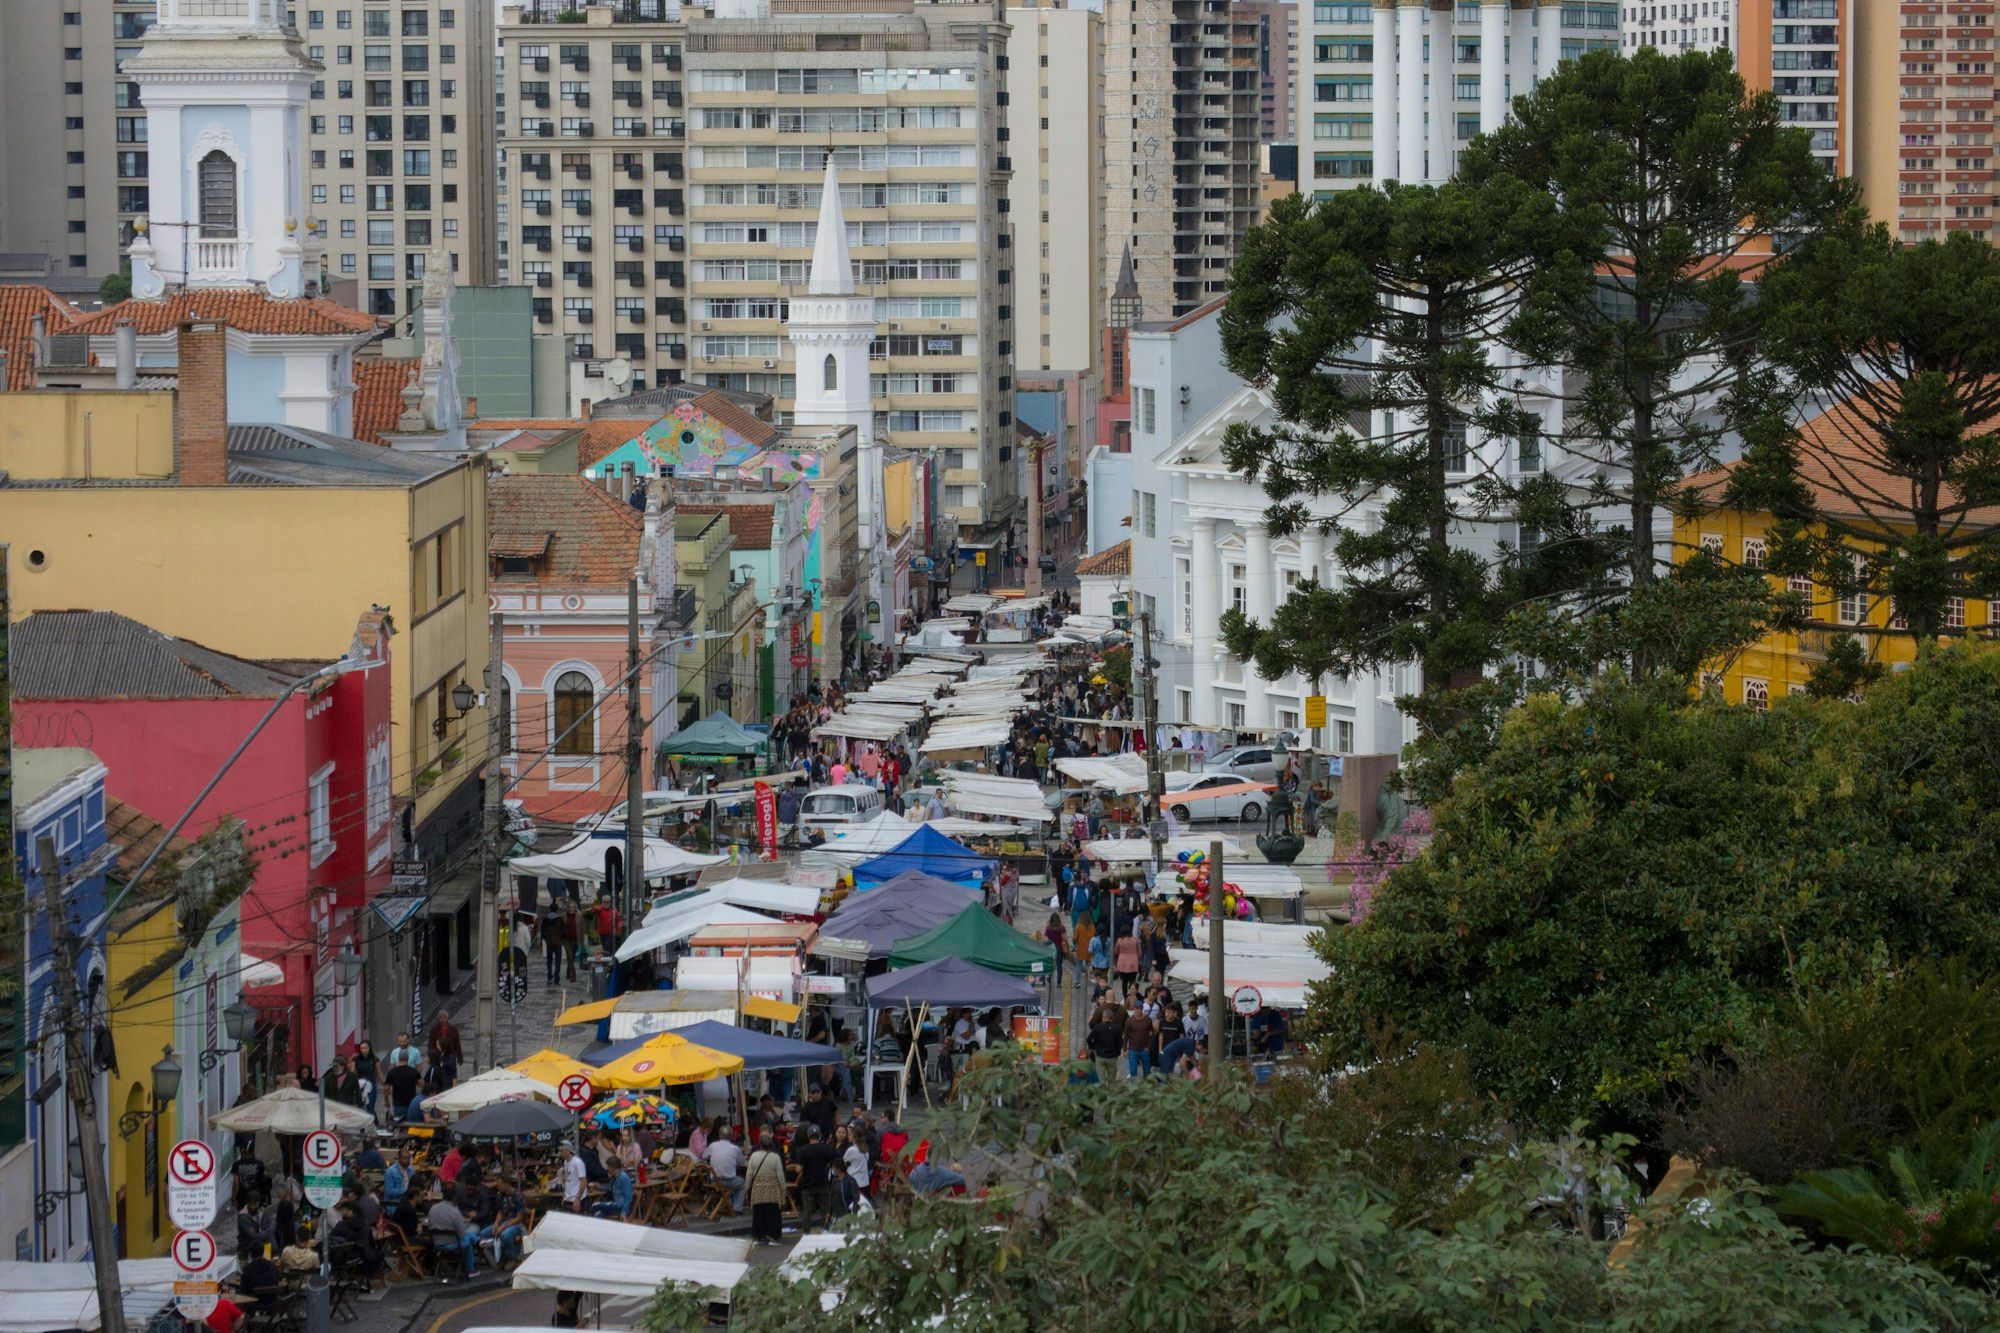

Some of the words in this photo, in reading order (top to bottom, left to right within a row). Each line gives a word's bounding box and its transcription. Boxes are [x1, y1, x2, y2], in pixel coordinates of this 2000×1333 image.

[537, 1131, 551, 1142] elo
[316, 1139, 328, 1160] E
[183, 1149, 199, 1175] E
[187, 1238, 201, 1262] E
